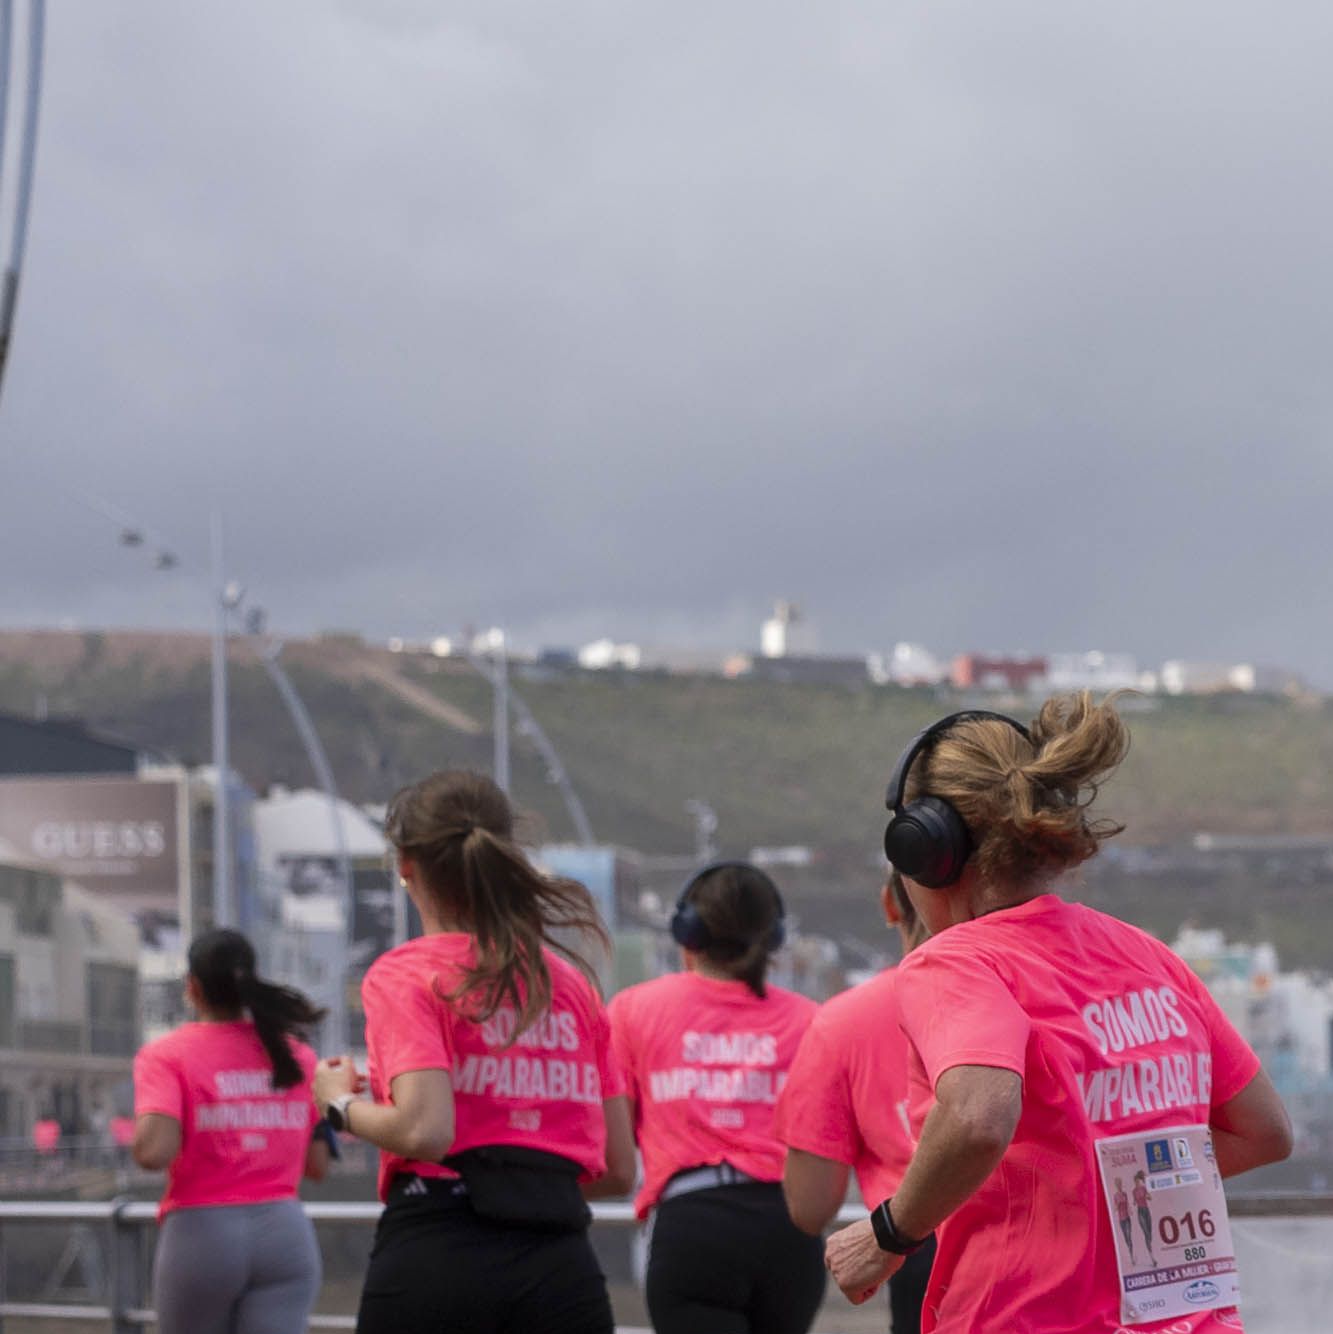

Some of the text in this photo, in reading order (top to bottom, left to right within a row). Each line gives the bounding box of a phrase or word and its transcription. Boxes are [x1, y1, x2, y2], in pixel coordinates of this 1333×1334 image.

[32, 822, 165, 858] GUESS
[1083, 987, 1188, 1056] SOMOS
[683, 1031, 777, 1065] SOMOS
[1158, 1209, 1215, 1244] 016
[1184, 1246, 1206, 1261] 880
